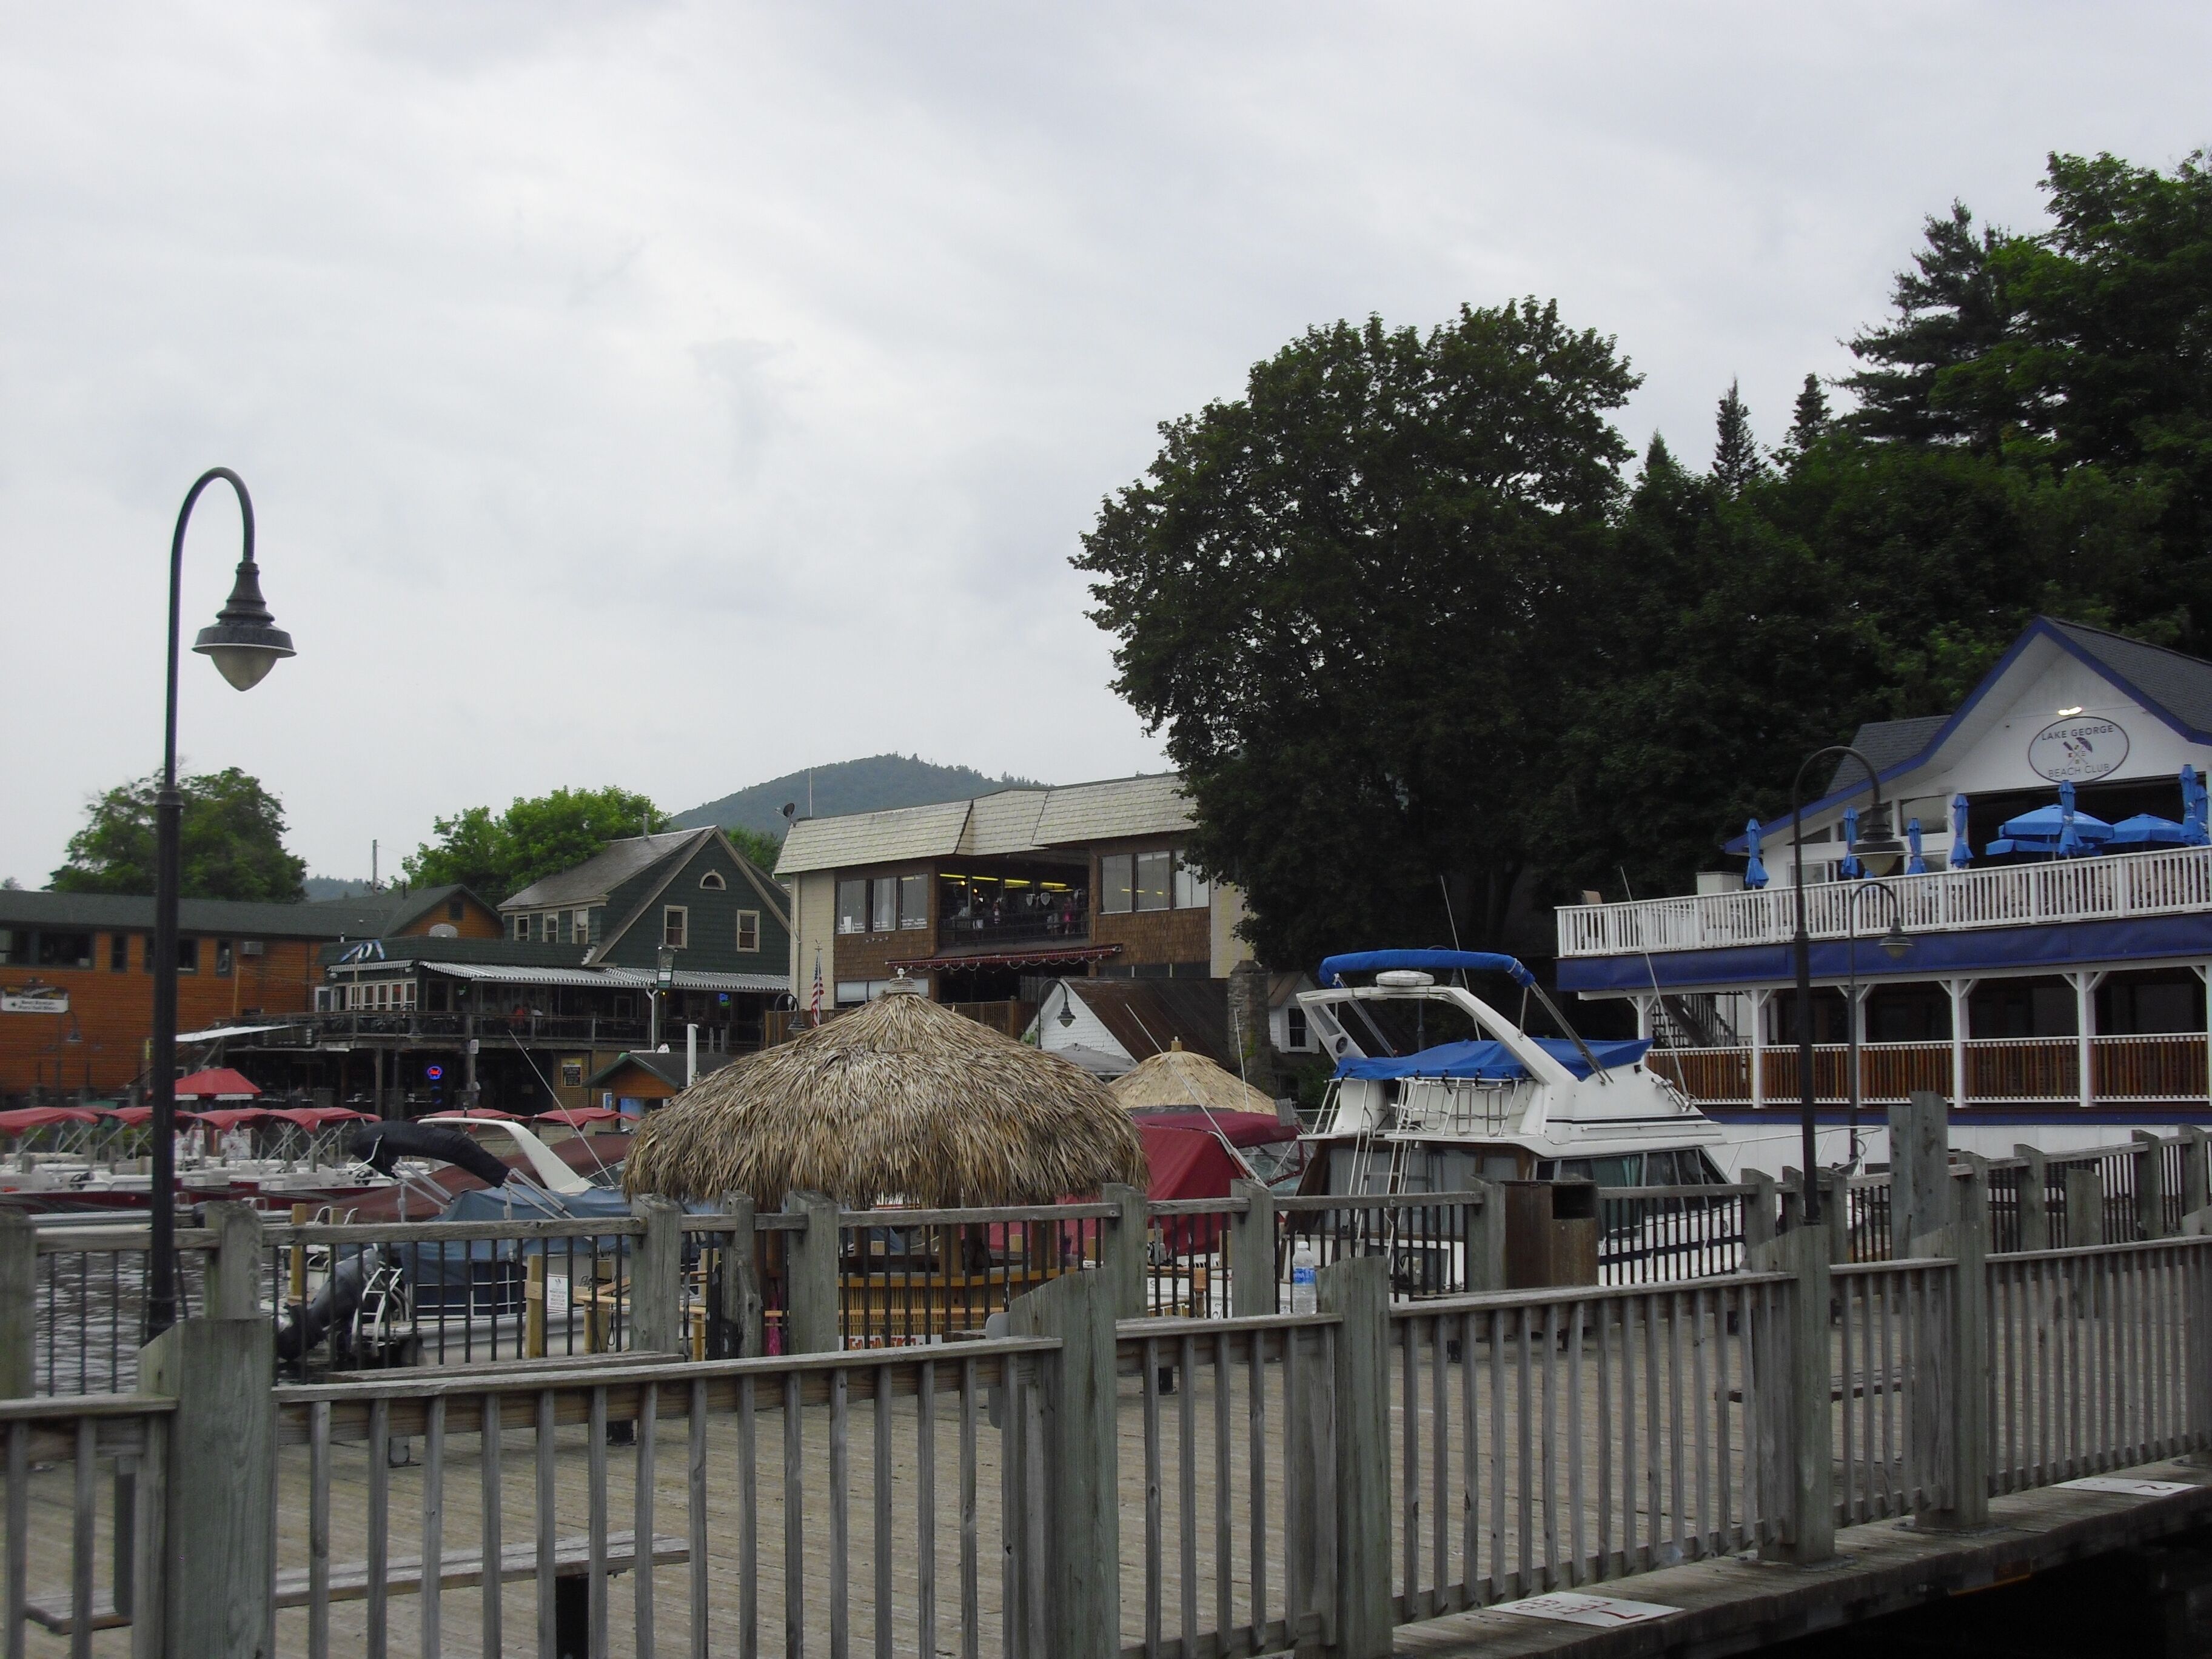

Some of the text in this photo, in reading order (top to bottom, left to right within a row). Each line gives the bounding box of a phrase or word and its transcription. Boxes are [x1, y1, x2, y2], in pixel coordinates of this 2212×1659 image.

[2041, 725, 2114, 740] LAKE GEORGE
[2048, 763, 2110, 777] BEACH CLUB
